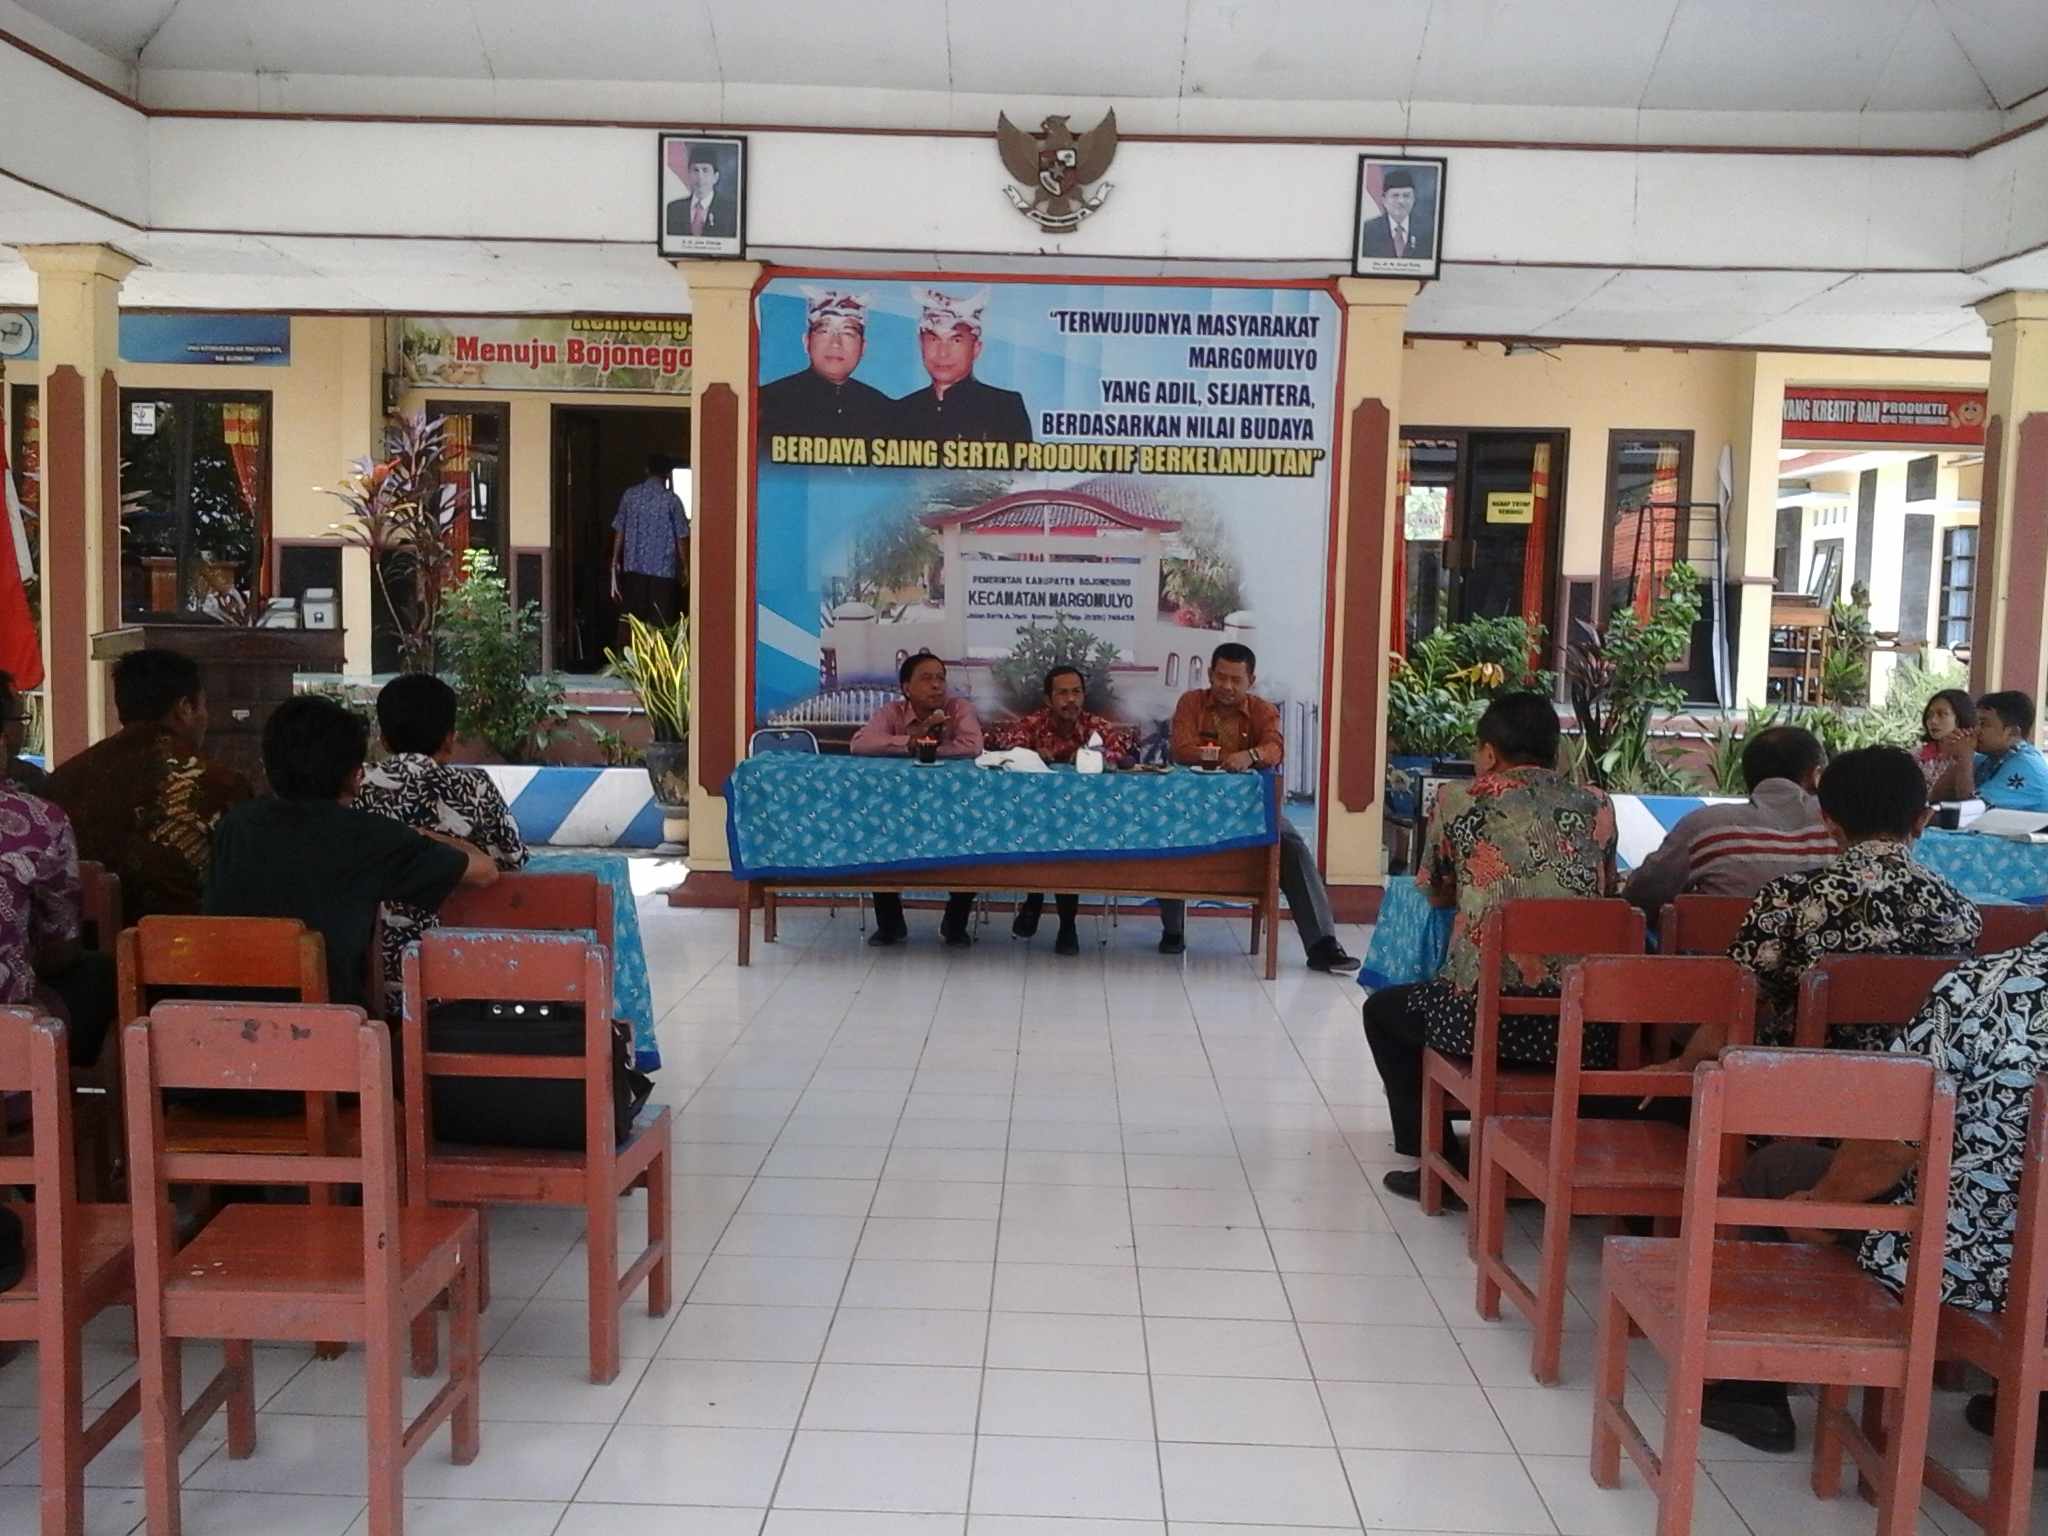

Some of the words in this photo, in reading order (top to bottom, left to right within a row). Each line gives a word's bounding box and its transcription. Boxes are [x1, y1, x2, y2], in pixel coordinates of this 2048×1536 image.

[1199, 313, 1320, 338] MASYARAKAT
[456, 336, 556, 369] Menuju
[1189, 346, 1318, 370] MARGOMULYO
[1102, 380, 1150, 404] YANG
[1155, 381, 1202, 407] ADIL,
[1207, 383, 1316, 408] SEJAHTERA,
[1811, 398, 1857, 423] KREATIF
[1857, 400, 1880, 423] DAN
[1042, 412, 1181, 438] BERDASARKAN
[1187, 415, 1235, 439] NILAI
[1240, 418, 1314, 441] BUDAYA
[770, 434, 869, 465] BERDAYA
[871, 437, 938, 467] SAING
[942, 439, 1010, 469] SERTA
[1013, 442, 1138, 473] PRODUKTIF
[968, 590, 1046, 607] KECAMATAN
[1049, 592, 1133, 608] MARGOMULYO
